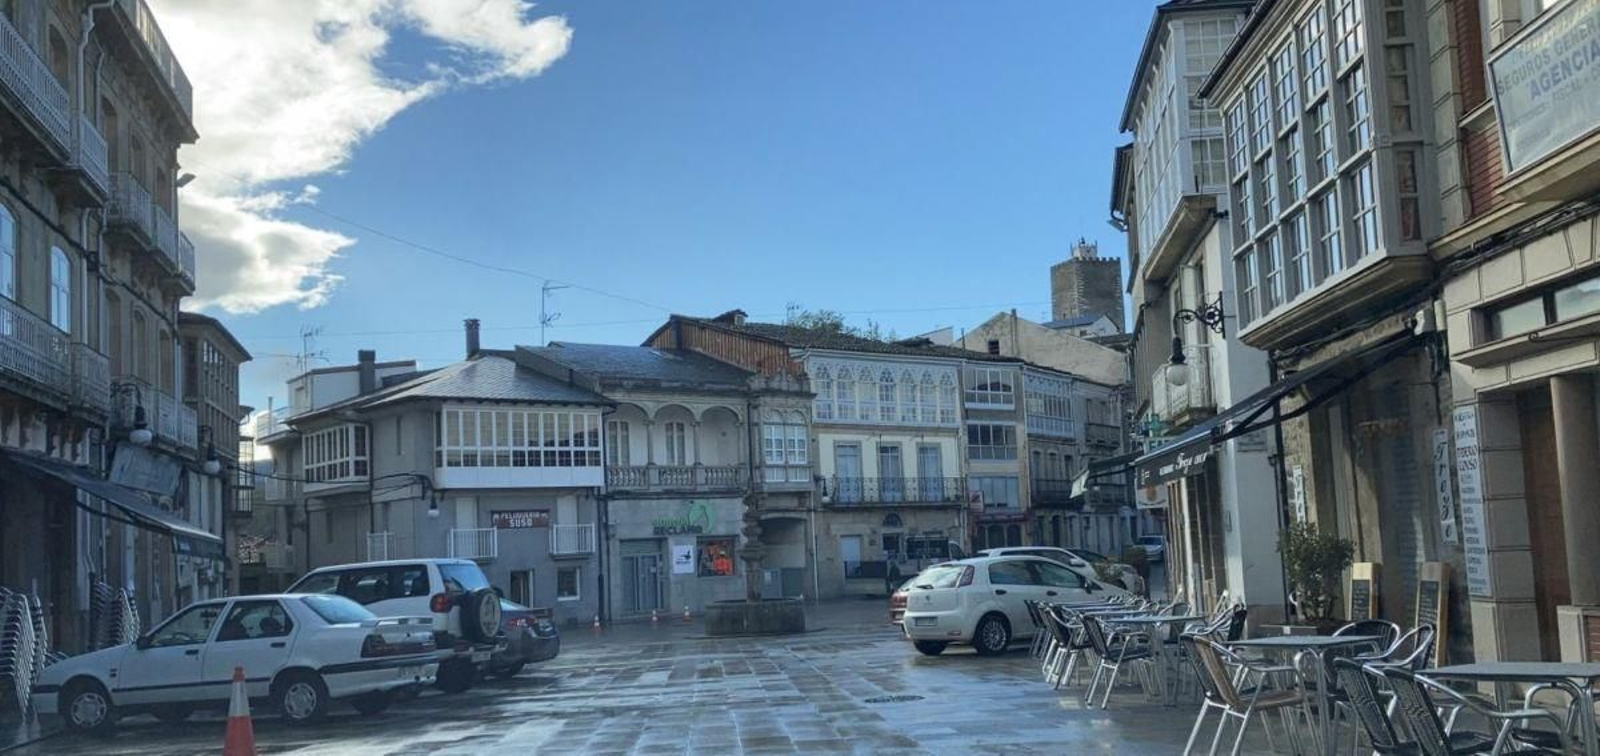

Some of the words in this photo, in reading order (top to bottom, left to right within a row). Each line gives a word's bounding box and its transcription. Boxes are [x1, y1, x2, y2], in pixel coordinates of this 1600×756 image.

[1497, 47, 1551, 96] SEGUROS
[1554, 10, 1600, 56] GENER
[1530, 38, 1600, 101] AGENCIA
[509, 518, 533, 527] SUSO
